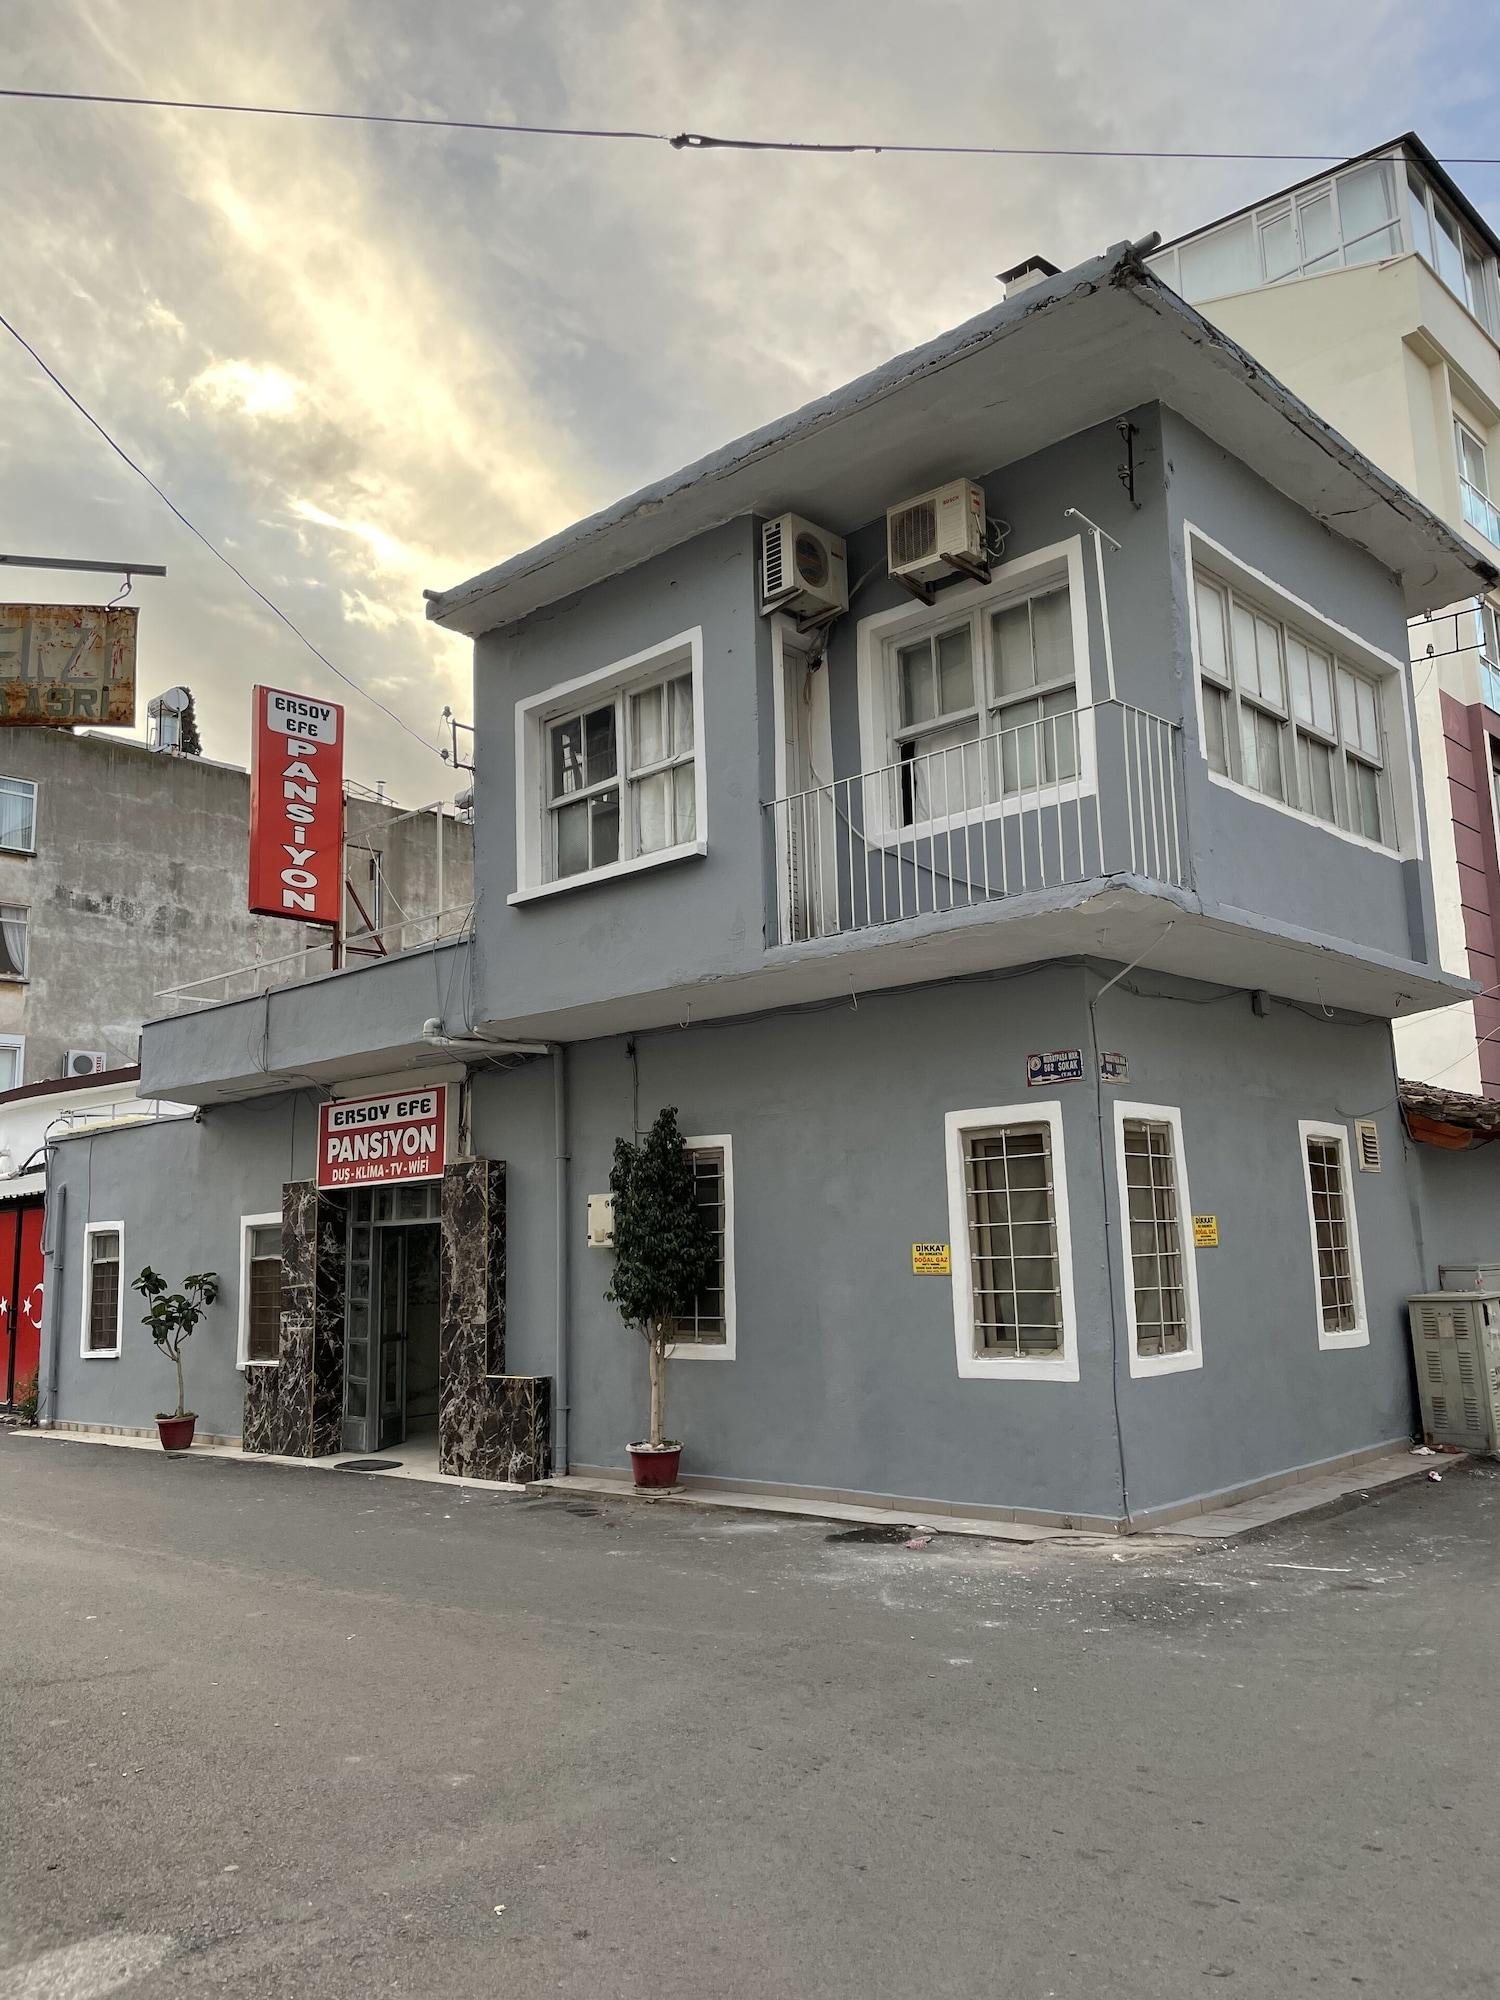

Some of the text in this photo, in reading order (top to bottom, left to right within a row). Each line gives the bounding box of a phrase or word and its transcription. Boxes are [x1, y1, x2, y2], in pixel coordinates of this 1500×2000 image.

[275, 697, 330, 721] ERSOY
[286, 718, 318, 737] EFE
[1057, 1060, 1079, 1071] SOKAK
[334, 1098, 431, 1126] ERSOY EFE
